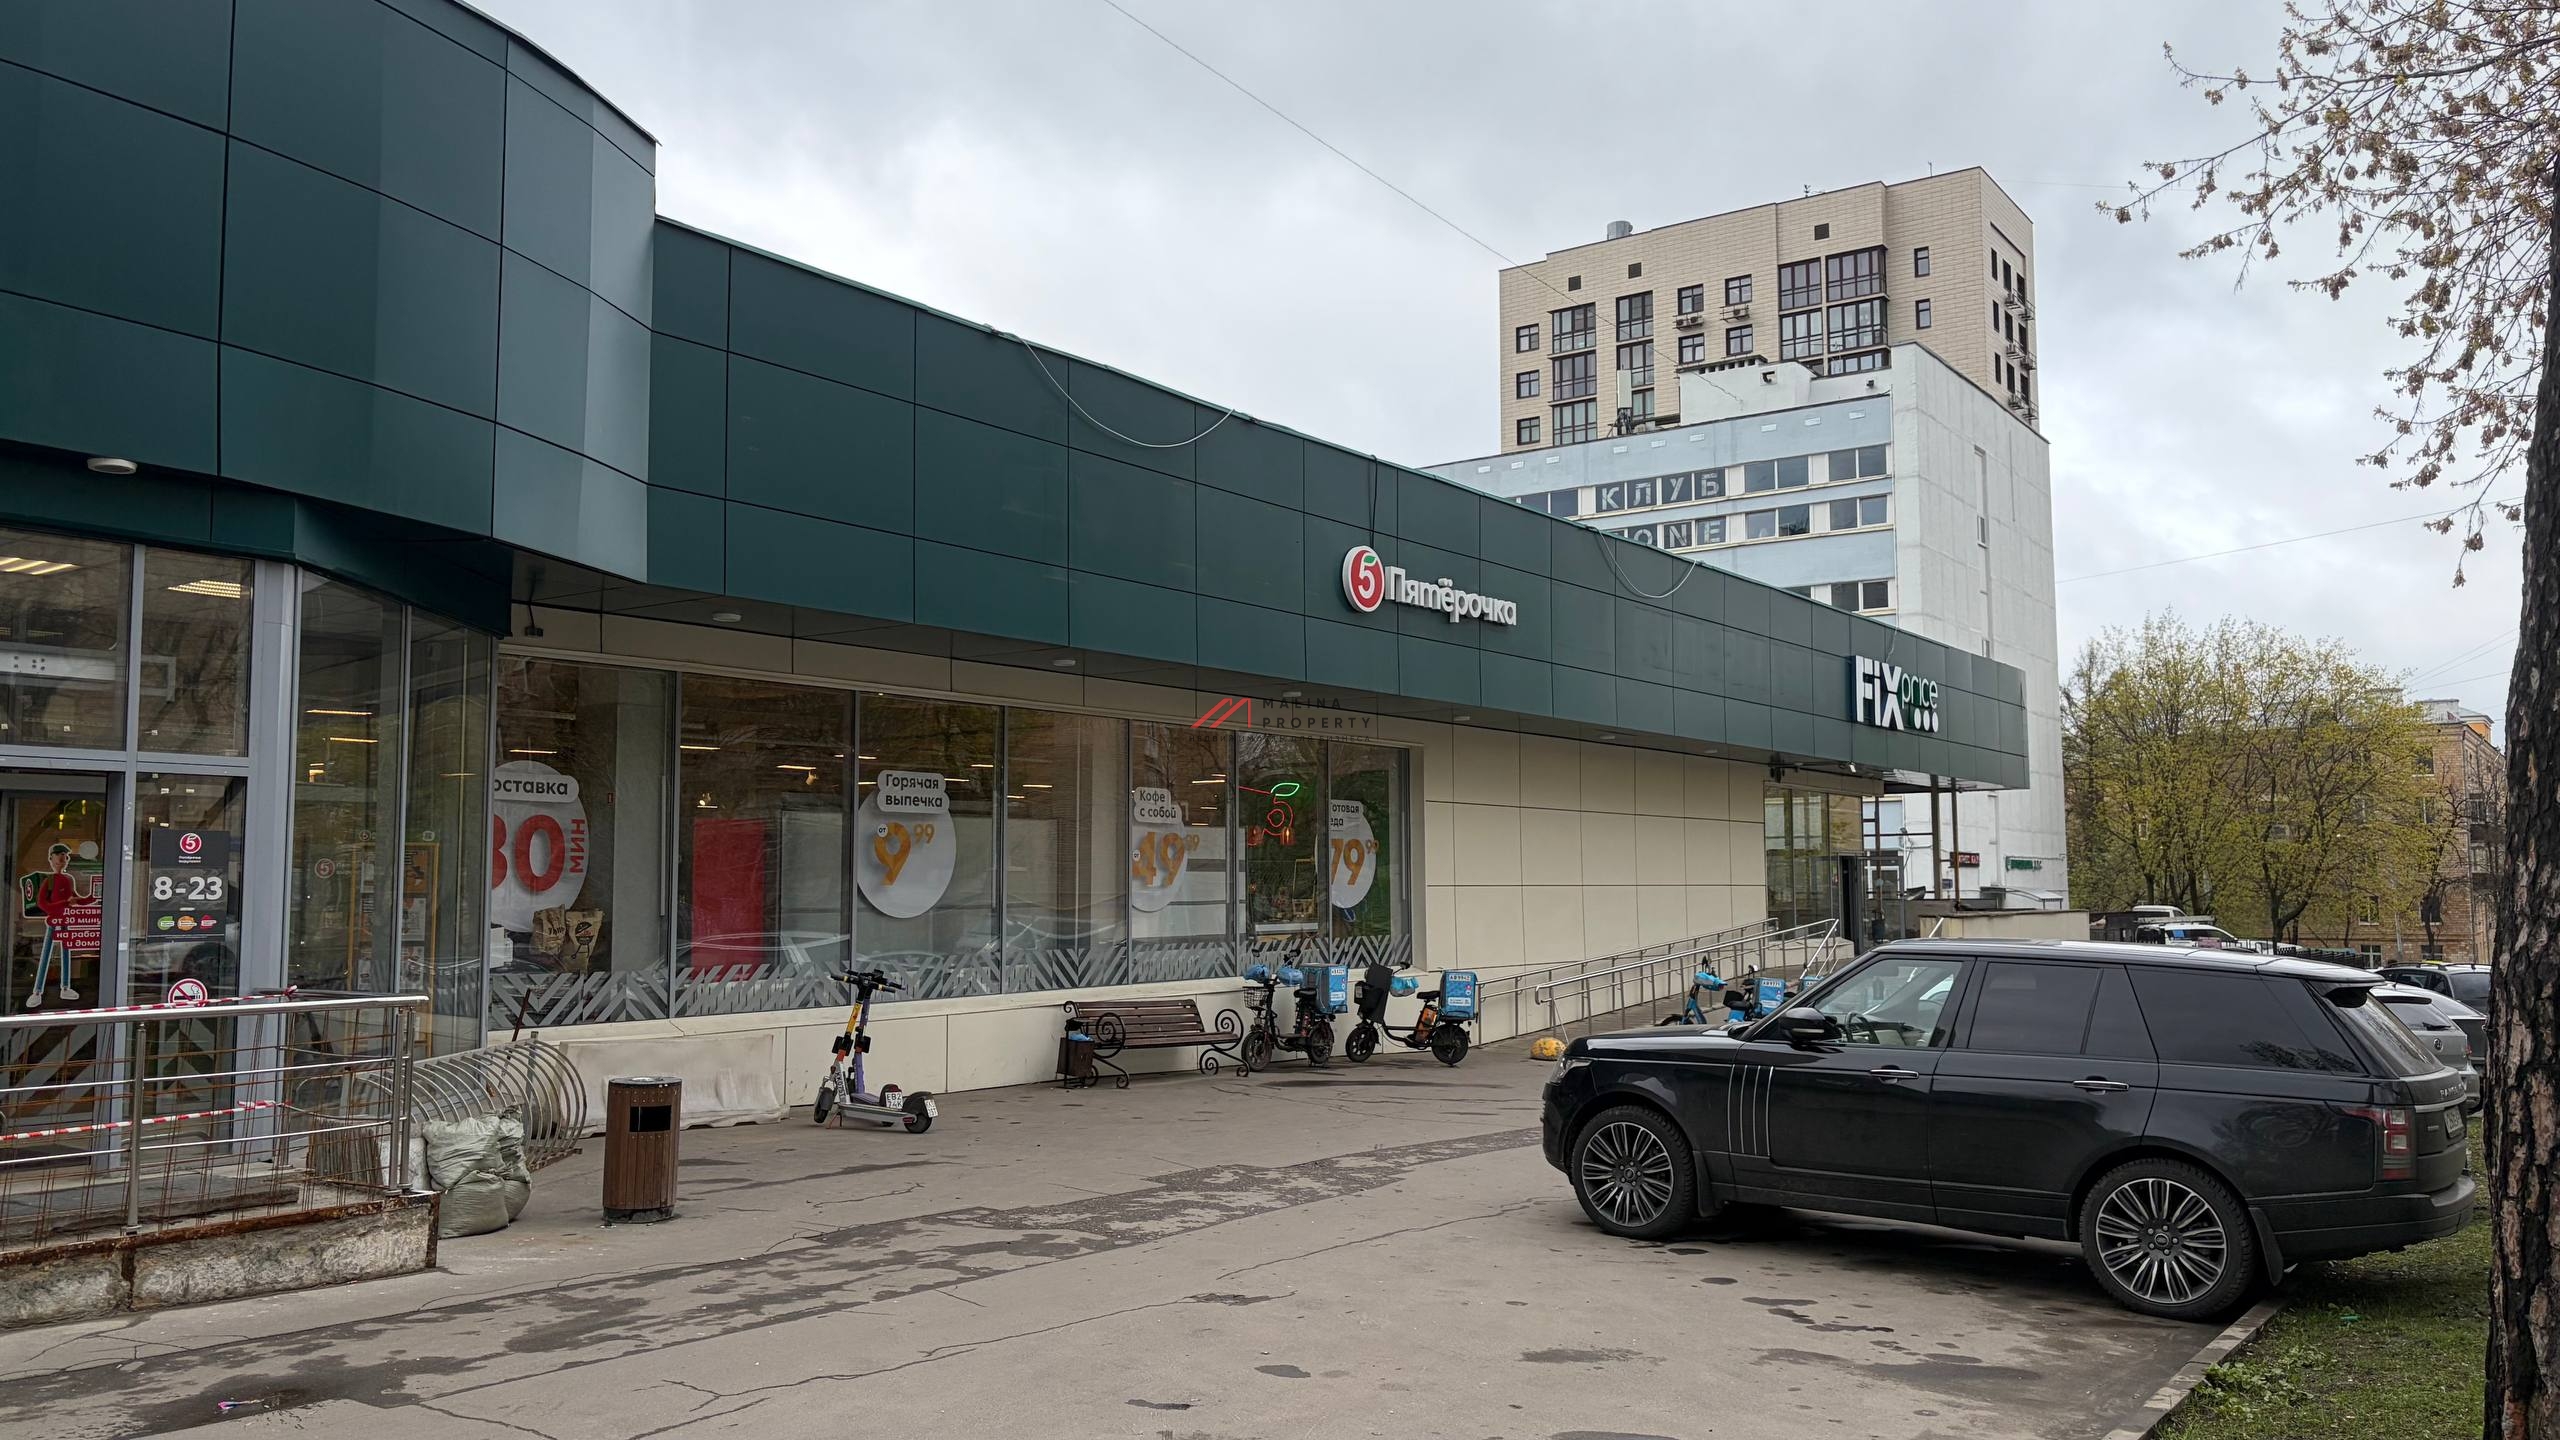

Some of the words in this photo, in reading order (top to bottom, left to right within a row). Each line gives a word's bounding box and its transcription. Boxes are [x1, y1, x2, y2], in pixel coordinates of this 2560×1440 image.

[1601, 472, 1720, 511] КЛУБ
[1611, 520, 1721, 549] ONE
[1385, 565, 1517, 626] Пятёрочка
[1901, 672, 1939, 709] price
[493, 778, 569, 796] оставка
[885, 773, 939, 791] Горячая
[885, 794, 943, 808] выпечка
[1140, 790, 1166, 805] Кофе
[1147, 806, 1177, 819] собой
[1330, 803, 1360, 814] отовая
[873, 821, 912, 887] 9
[913, 823, 935, 845] 99
[1132, 831, 1185, 887] 49
[63, 907, 102, 916] Доставк
[77, 918, 101, 926] мину
[71, 931, 101, 940] работ
